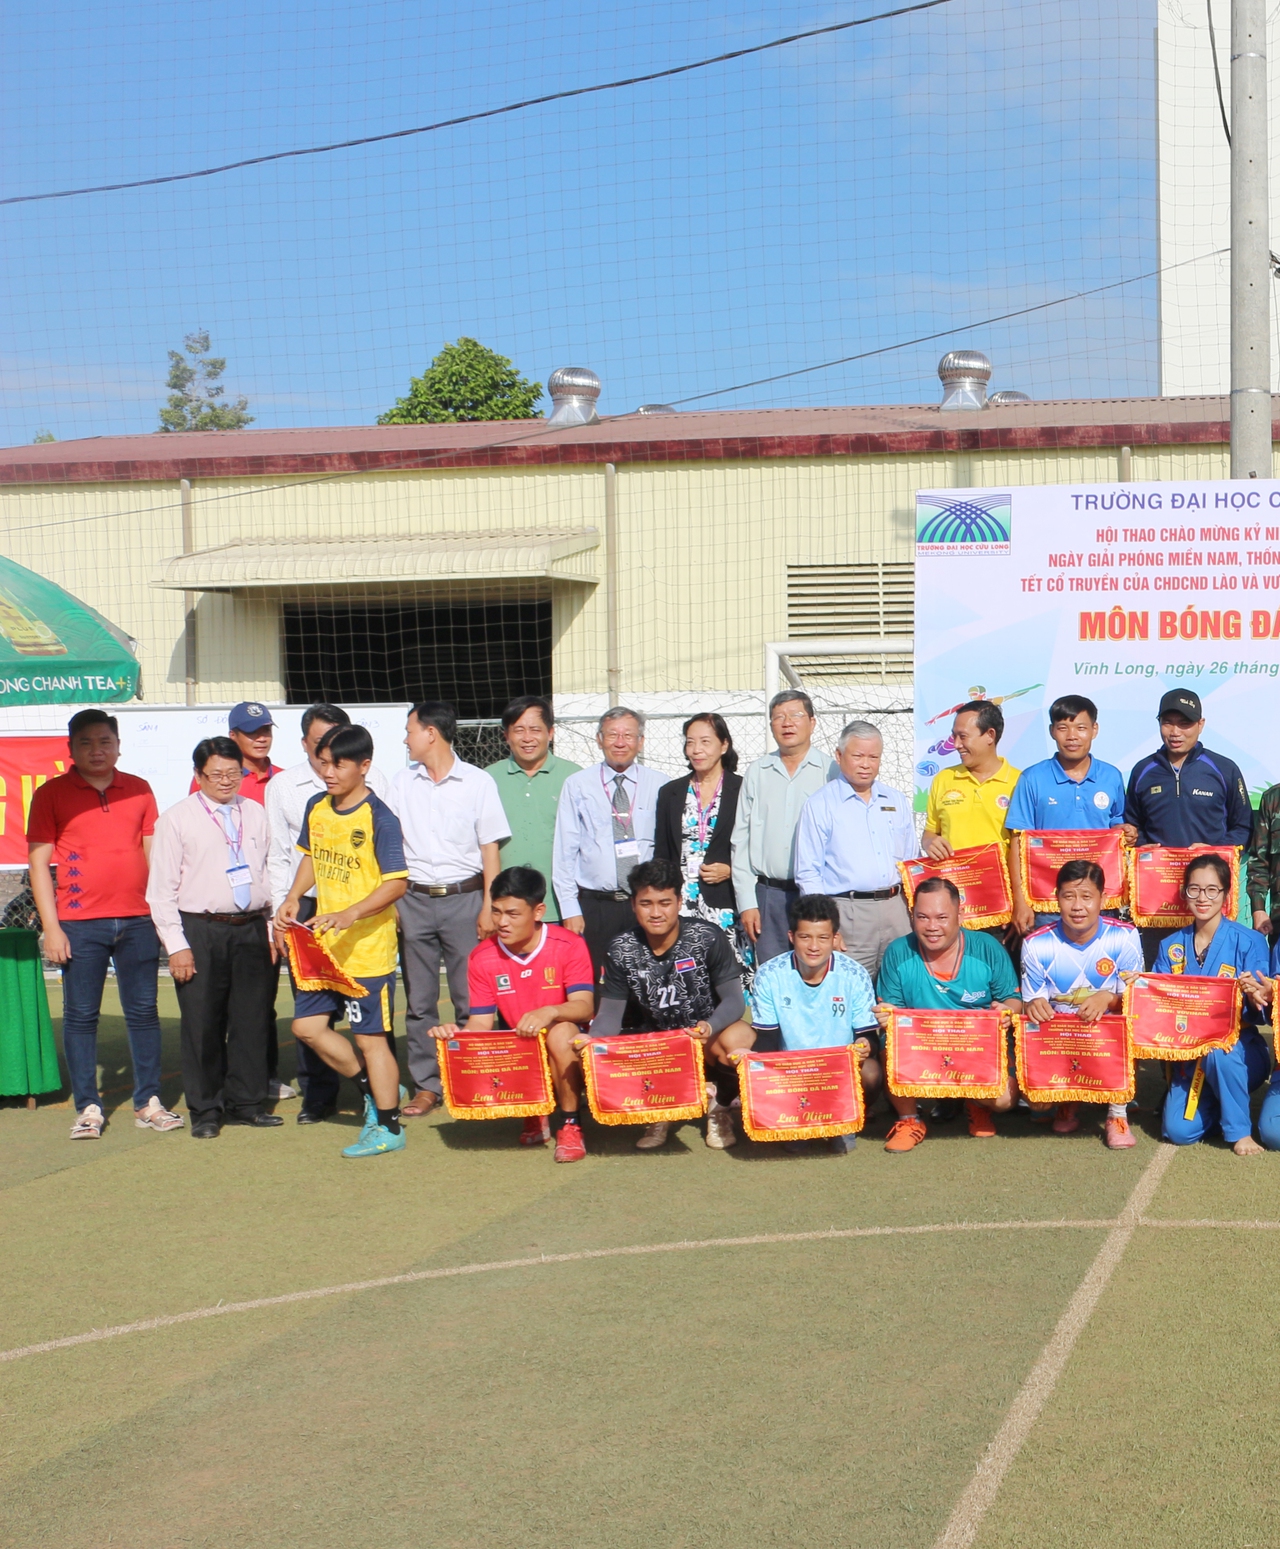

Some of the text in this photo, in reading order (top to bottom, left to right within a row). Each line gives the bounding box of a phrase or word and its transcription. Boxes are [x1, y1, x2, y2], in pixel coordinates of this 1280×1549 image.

[1071, 489, 1163, 510] TRƯỜNG
[1171, 493, 1207, 512] ĐẠI
[1215, 491, 1261, 512] HỌC
[1096, 527, 1118, 546] HỘI
[1122, 528, 1157, 543] THAO
[1160, 524, 1196, 542] CHÀO
[1200, 524, 1240, 541] MỪNG
[1244, 522, 1261, 541] KỶ
[1049, 550, 1082, 568] NGÀY
[1088, 549, 1115, 567] GIẢI
[1118, 549, 1164, 567] PHÓNG
[1168, 546, 1203, 566] MIỀN
[1207, 551, 1242, 567] NAM,
[1021, 574, 1044, 592] TẾT
[1047, 573, 1064, 592] CỔ
[1068, 573, 1120, 592] TRUYỀN
[1123, 573, 1150, 591] CỦA
[1153, 575, 1208, 591] CHDCND
[1212, 573, 1238, 590] LÀO
[1241, 572, 1259, 590] VÀ
[1078, 605, 1149, 641] MÔN
[1158, 605, 1241, 640] BÓNG
[1073, 661, 1108, 676] Vĩnh
[1114, 662, 1160, 679] Long,
[1165, 661, 1205, 678] ngày
[1210, 661, 1228, 675] 26
[1233, 660, 1280, 678] tháng
[32, 676, 82, 692] CHANH
[657, 984, 680, 1009] 22
[832, 1003, 845, 1017] 99
